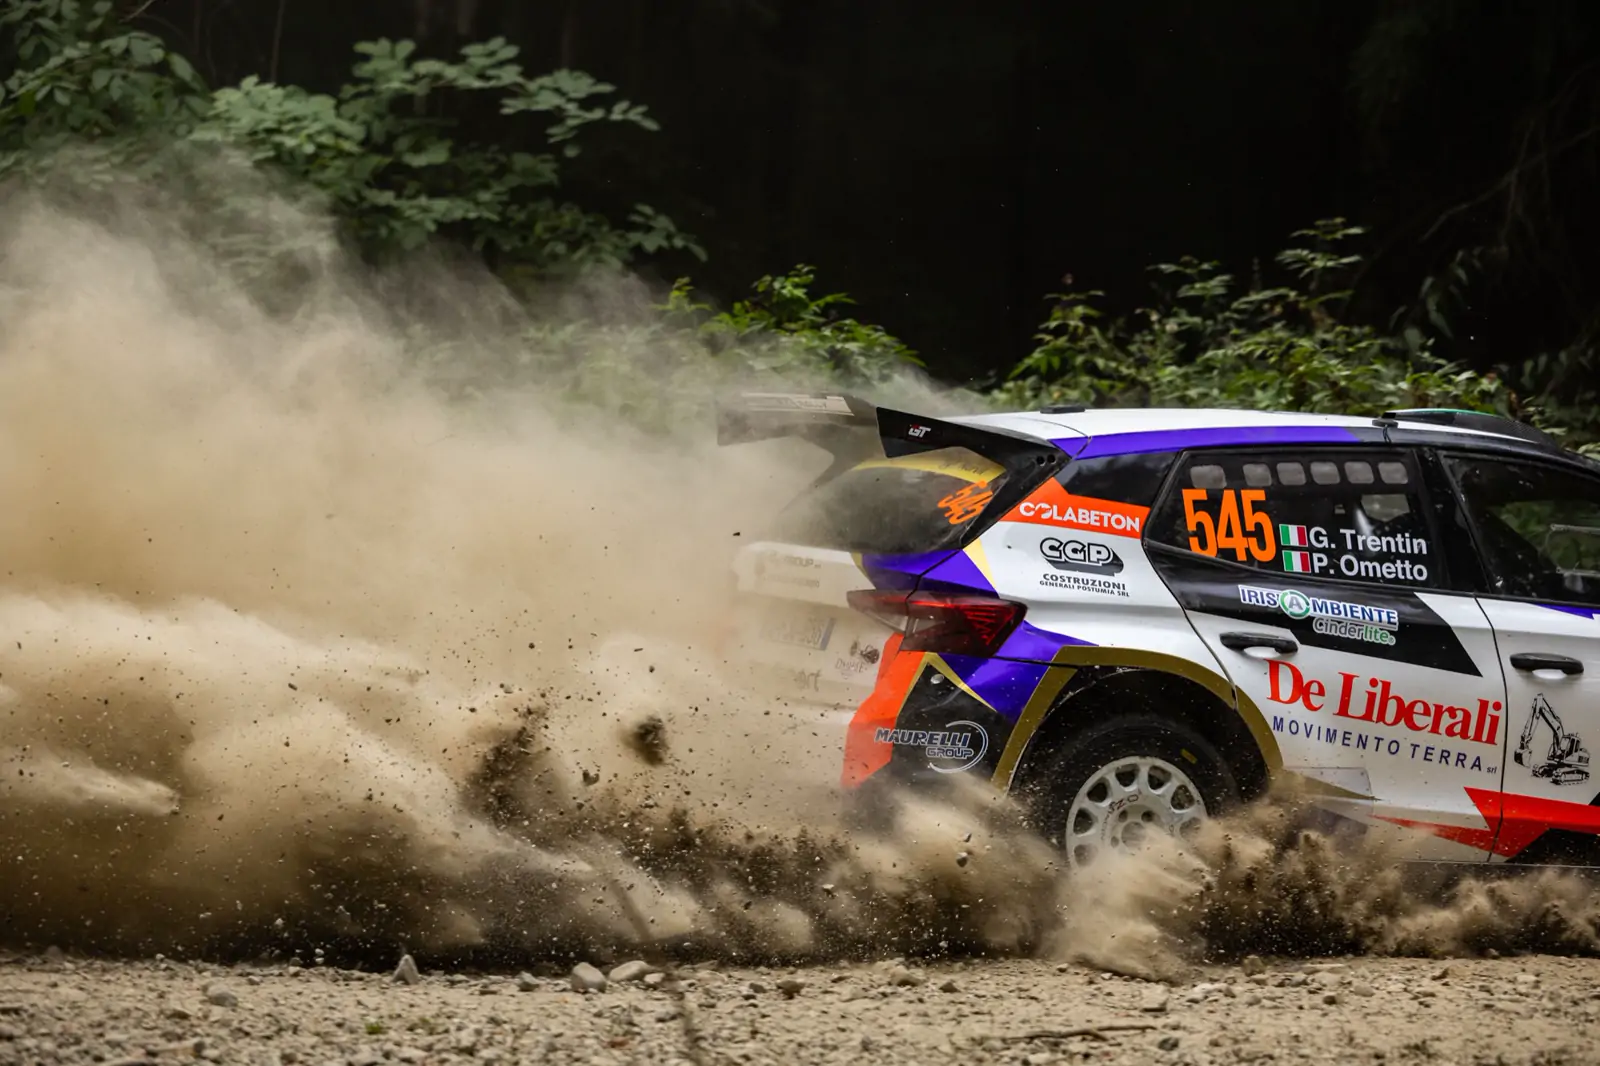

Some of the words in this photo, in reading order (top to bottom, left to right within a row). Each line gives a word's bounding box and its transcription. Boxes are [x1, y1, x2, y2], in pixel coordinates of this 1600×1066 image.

[1019, 502, 1139, 532] COLABETON
[1182, 488, 1276, 563] 545
[1309, 526, 1336, 550] G.
[1340, 528, 1427, 555] Trentin
[1312, 552, 1335, 575] P.
[1340, 554, 1428, 581] Ometto
[1040, 580, 1075, 590] GENERALI
[1077, 585, 1115, 595] POSTUMIA
[1117, 590, 1130, 598] SRL
[1043, 573, 1126, 591] COSTRUZIONI
[1264, 658, 1325, 711] De
[1332, 672, 1502, 746] Liberali
[874, 728, 971, 747] MAURELLI
[1273, 716, 1400, 755] MOVIMENTO
[1410, 743, 1482, 771] TERRA
[1486, 766, 1497, 774] srl
[926, 746, 974, 759] GROUP
